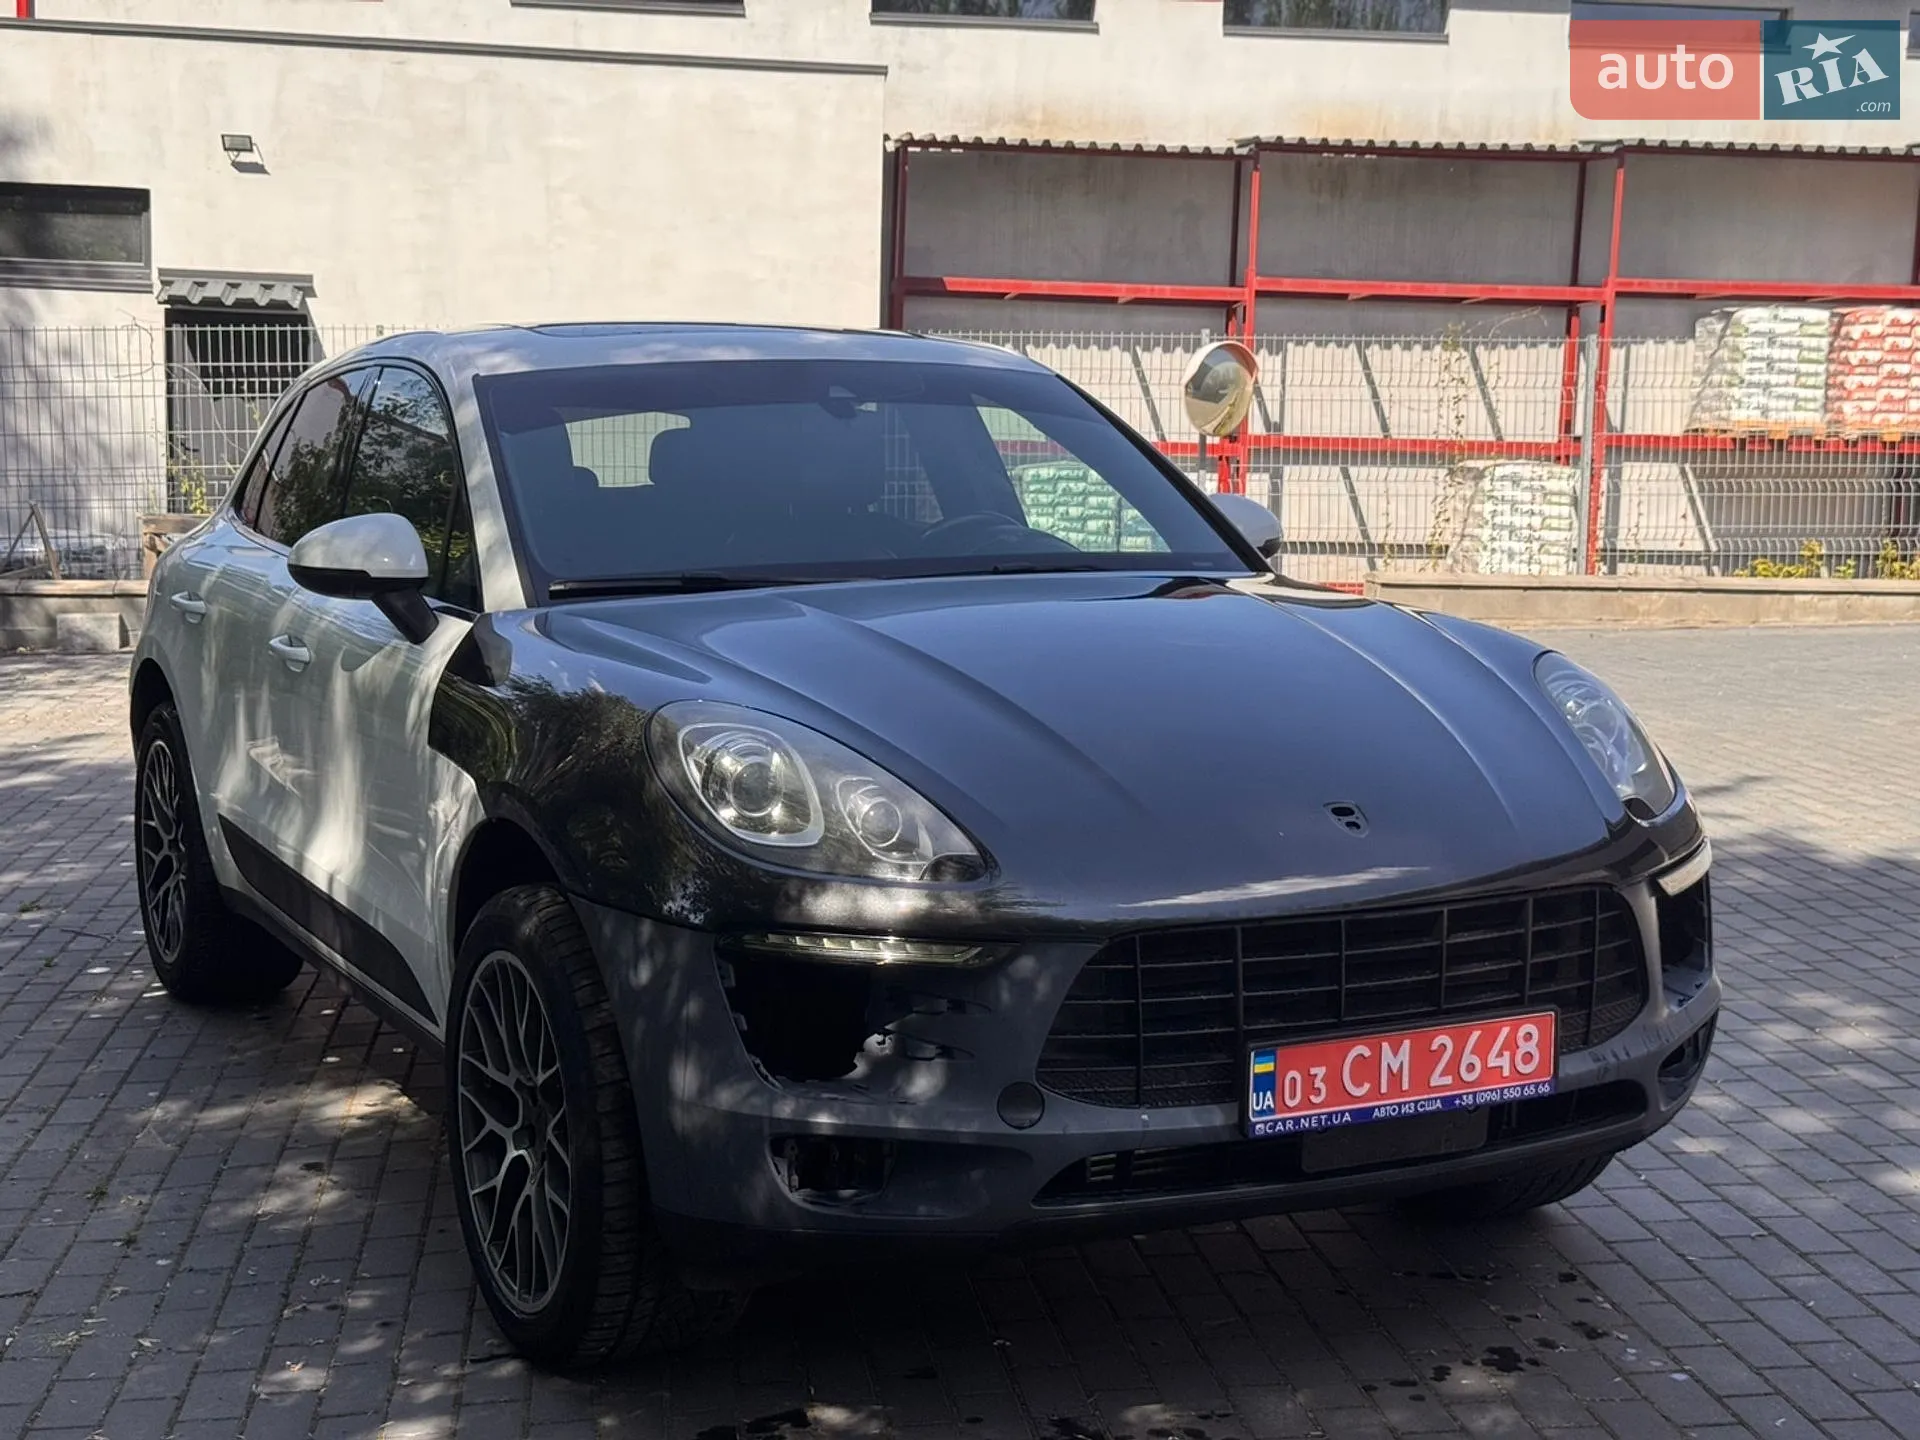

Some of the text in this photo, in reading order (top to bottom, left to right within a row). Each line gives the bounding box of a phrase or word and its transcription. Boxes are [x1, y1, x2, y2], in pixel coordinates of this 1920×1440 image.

[1283, 1023, 1541, 1108] 03 CM 2648
[1252, 1090, 1275, 1110] UA
